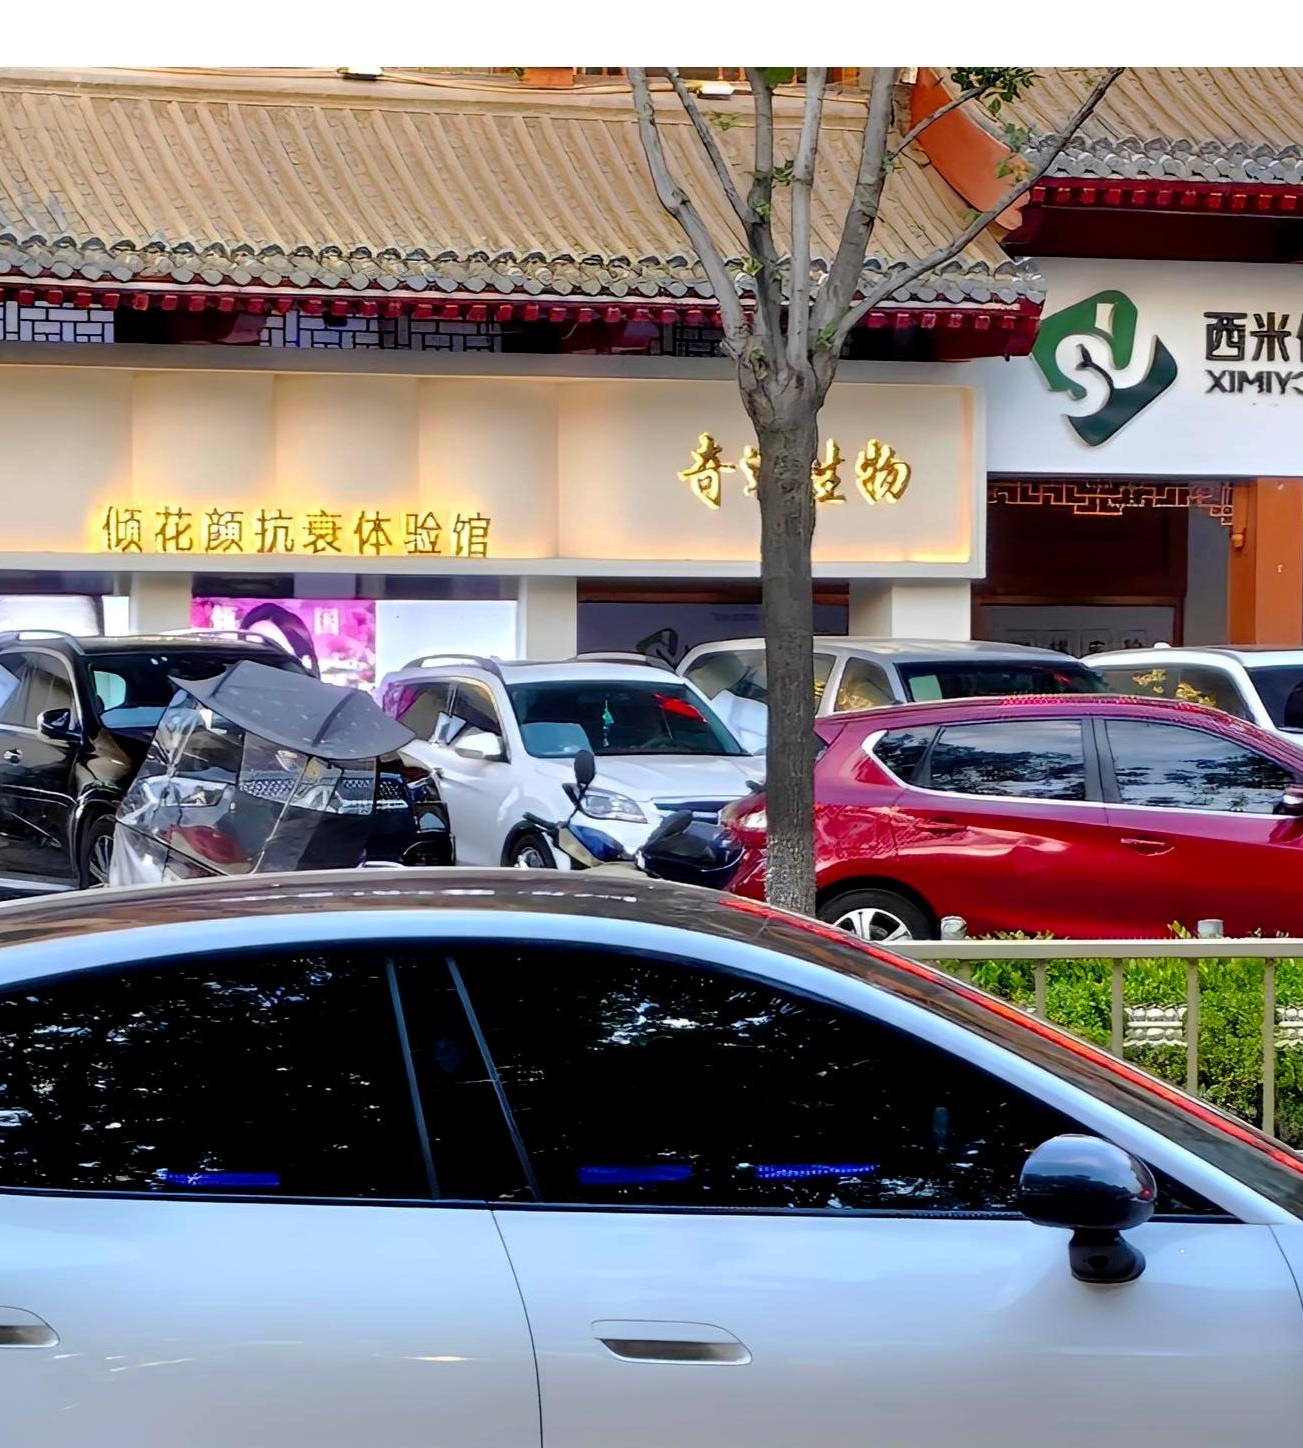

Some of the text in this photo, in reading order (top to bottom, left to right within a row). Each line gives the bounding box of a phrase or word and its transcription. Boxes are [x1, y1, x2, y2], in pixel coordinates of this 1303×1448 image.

[103, 505, 491, 558] 倾花颜抗衰体验馆
